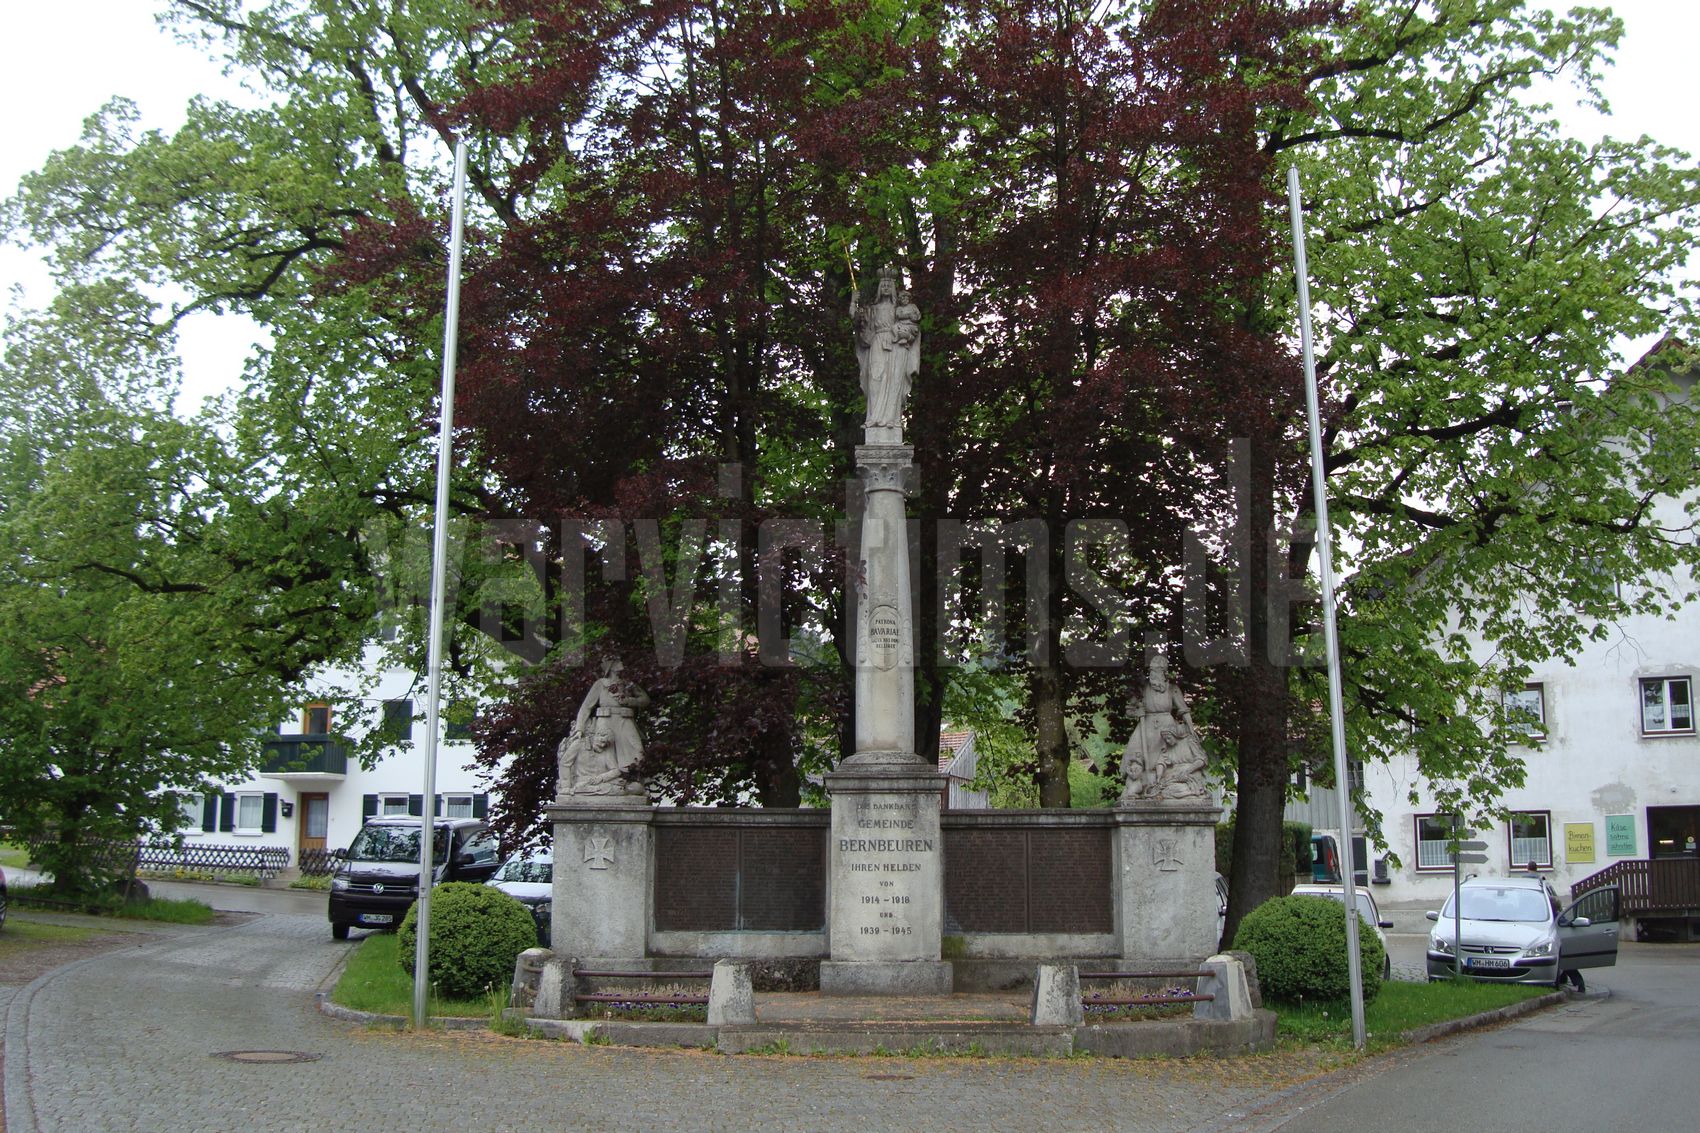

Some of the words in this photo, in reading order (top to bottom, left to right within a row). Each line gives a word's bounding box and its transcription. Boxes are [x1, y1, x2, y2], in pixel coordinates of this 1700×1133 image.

[858, 819, 914, 829] GEMEINDE
[840, 839, 933, 852] BERNBEUREN
[851, 864, 880, 872] IHREN
[883, 863, 922, 872] HELDEN
[861, 896, 880, 904] 1914
[892, 896, 910, 904] 1918
[860, 927, 880, 935] 1939
[892, 927, 912, 935] 1945
